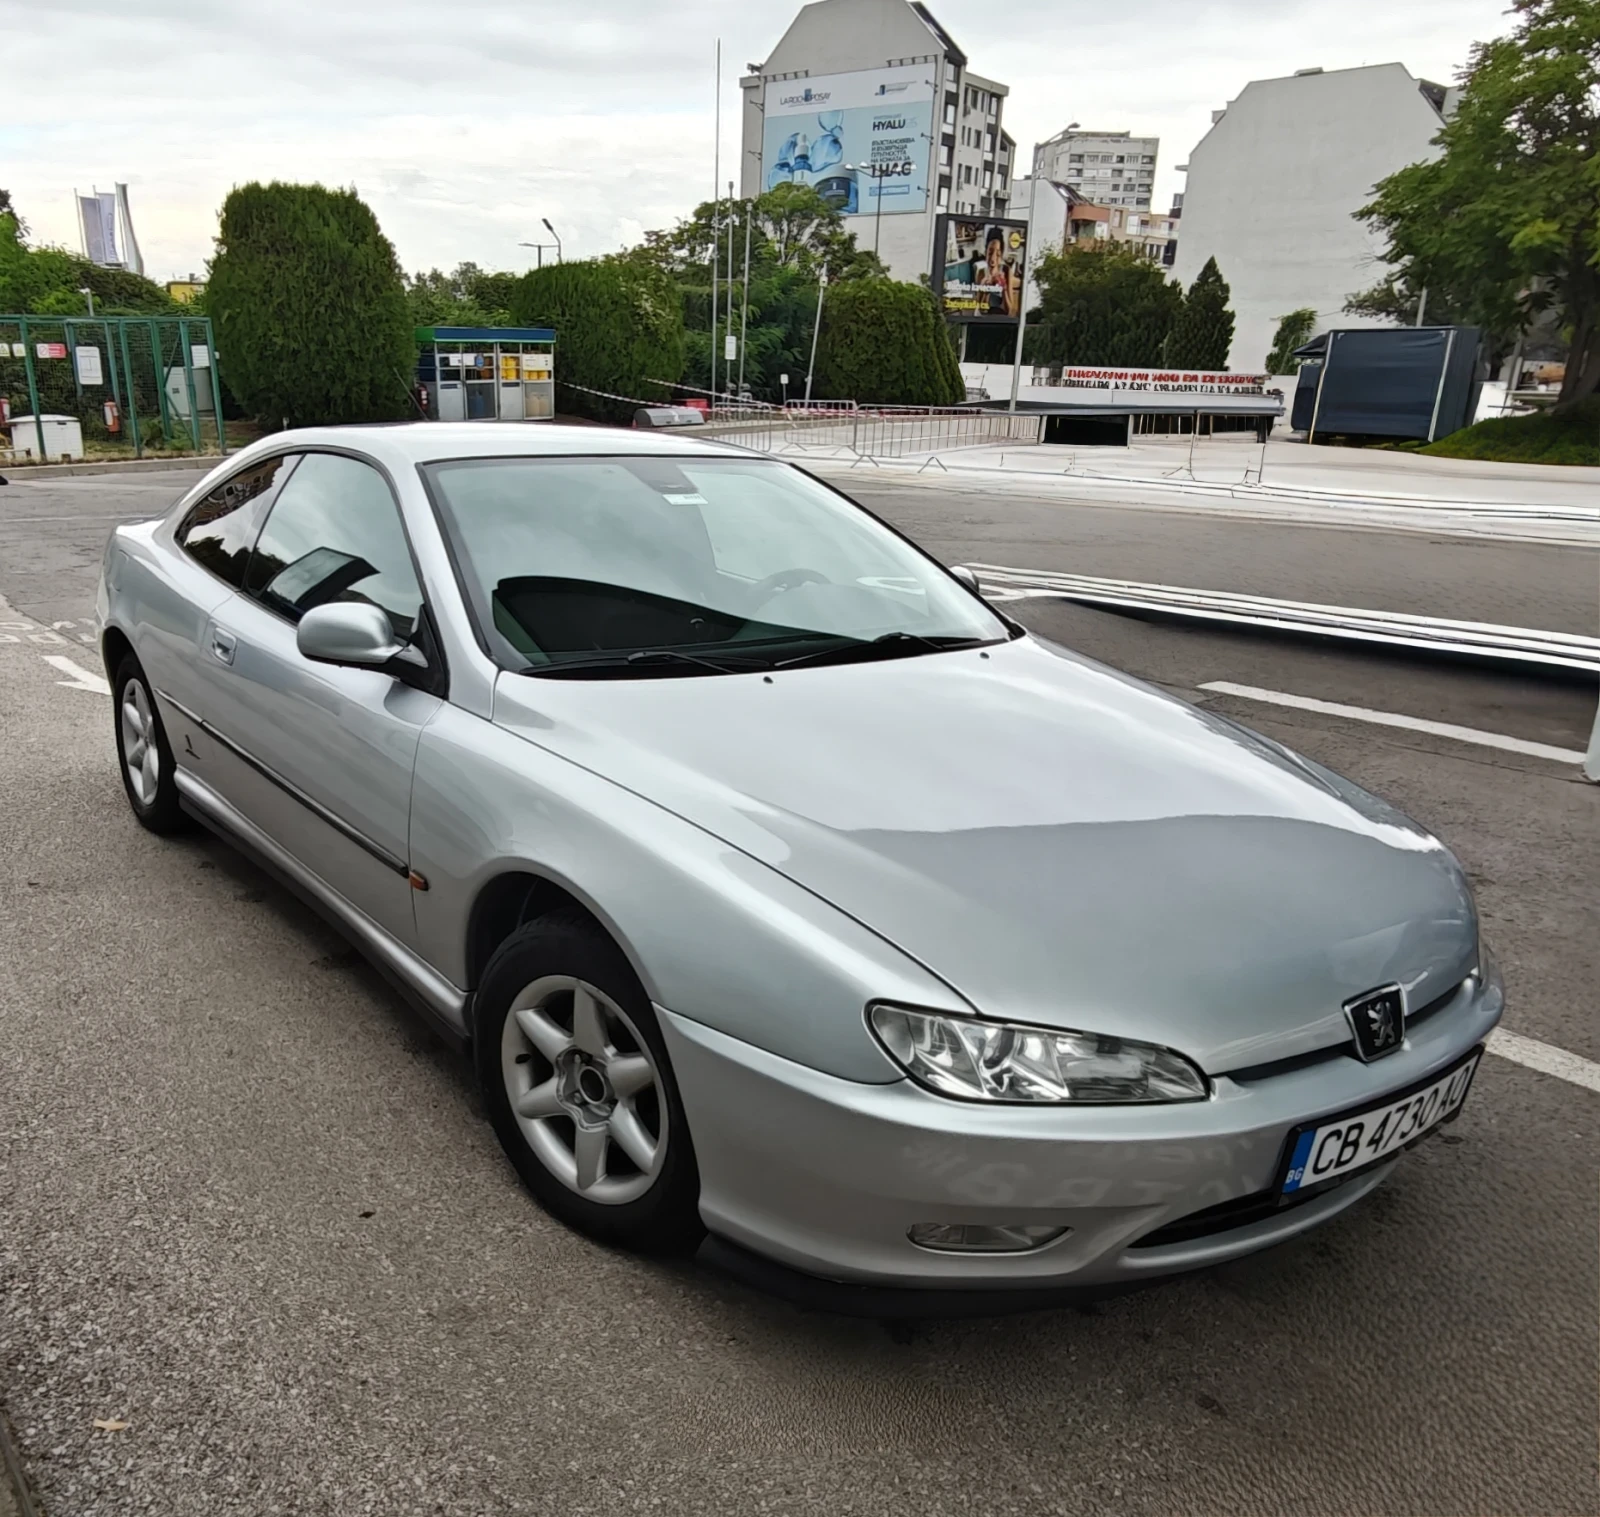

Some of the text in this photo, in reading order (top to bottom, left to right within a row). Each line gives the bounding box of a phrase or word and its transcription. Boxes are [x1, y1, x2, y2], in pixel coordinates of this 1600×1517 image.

[872, 118, 906, 131] HYALU
[1312, 1122, 1364, 1175] CB
[1366, 1087, 1439, 1153] 4730
[1285, 1167, 1303, 1184] BG
